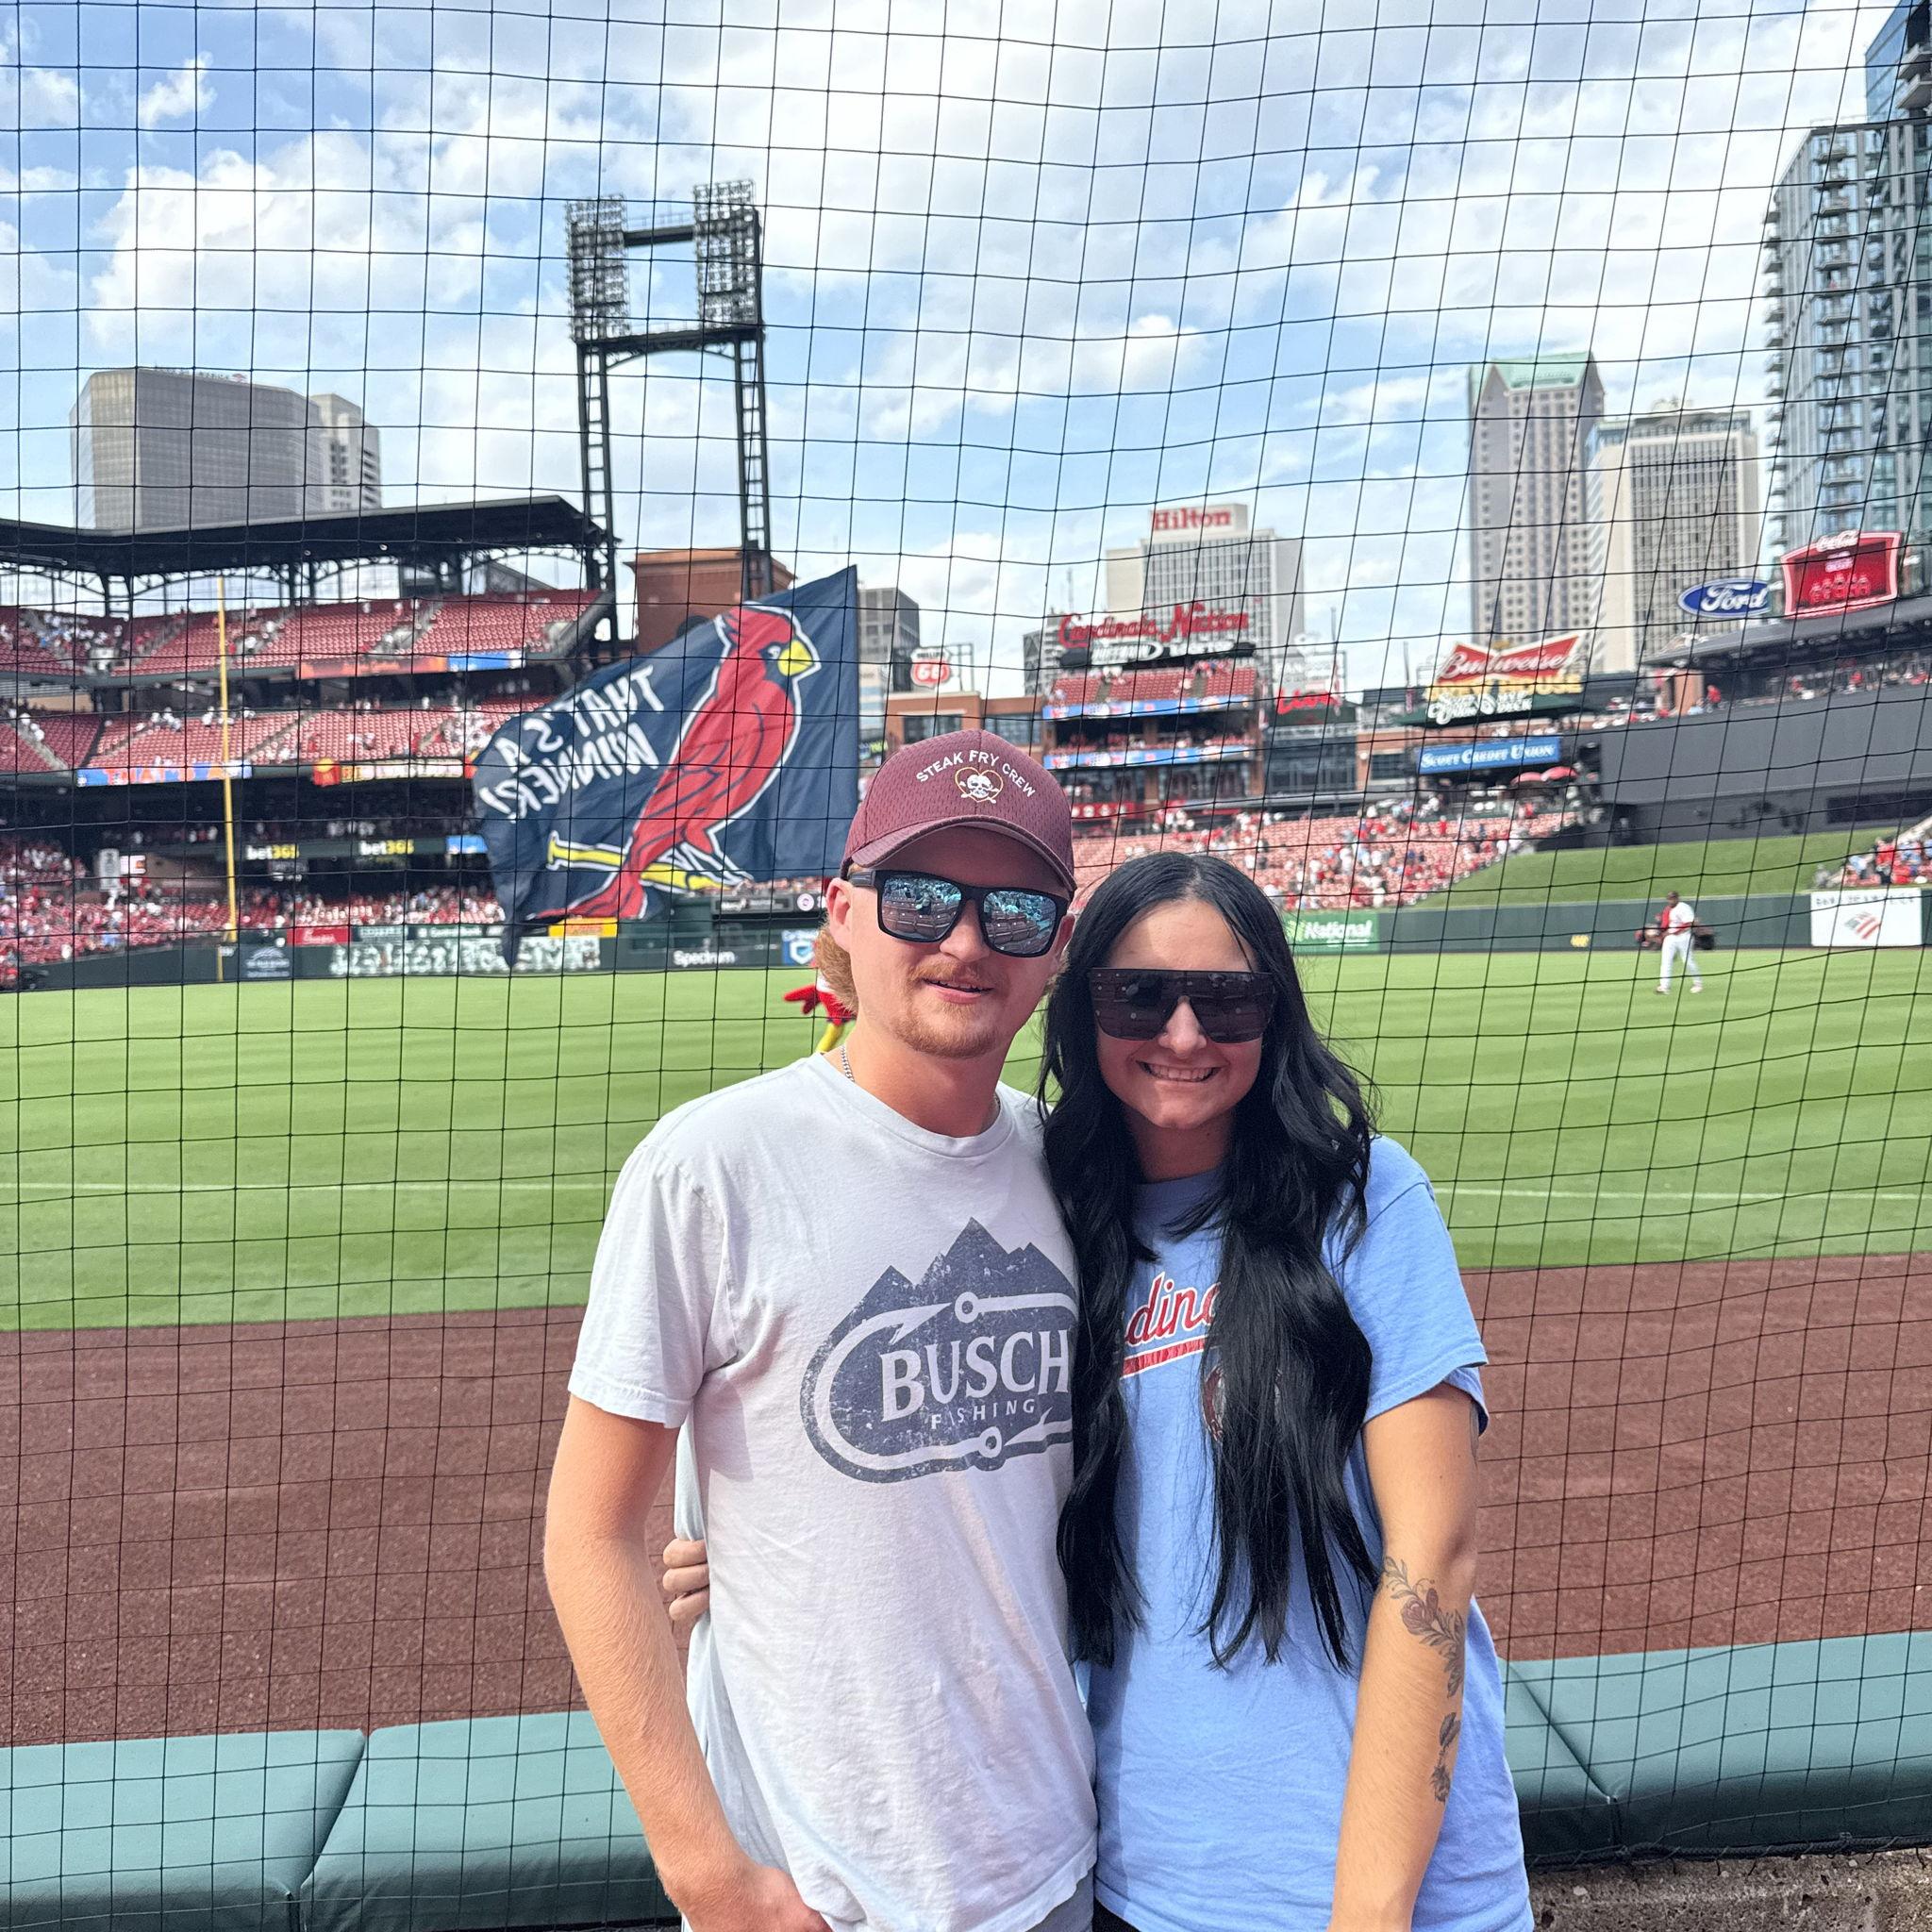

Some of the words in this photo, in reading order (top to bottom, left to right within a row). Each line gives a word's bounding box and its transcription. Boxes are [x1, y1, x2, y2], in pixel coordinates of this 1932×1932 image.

[1151, 508, 1231, 531] Hilton
[1700, 583, 1768, 611] Ford
[1058, 613, 1158, 648] Cardinals
[1158, 601, 1249, 642] Nation
[917, 663, 944, 680] 66
[916, 751, 964, 782] STEAK
[969, 750, 999, 767] FRY
[1002, 763, 1036, 797] CREW
[245, 843, 299, 859] bet365
[358, 839, 415, 856] bet365
[1304, 920, 1373, 940] National
[673, 950, 736, 967] Spectrum
[879, 1327, 1071, 1423] BUSCH
[930, 1398, 1036, 1430] FISHING
